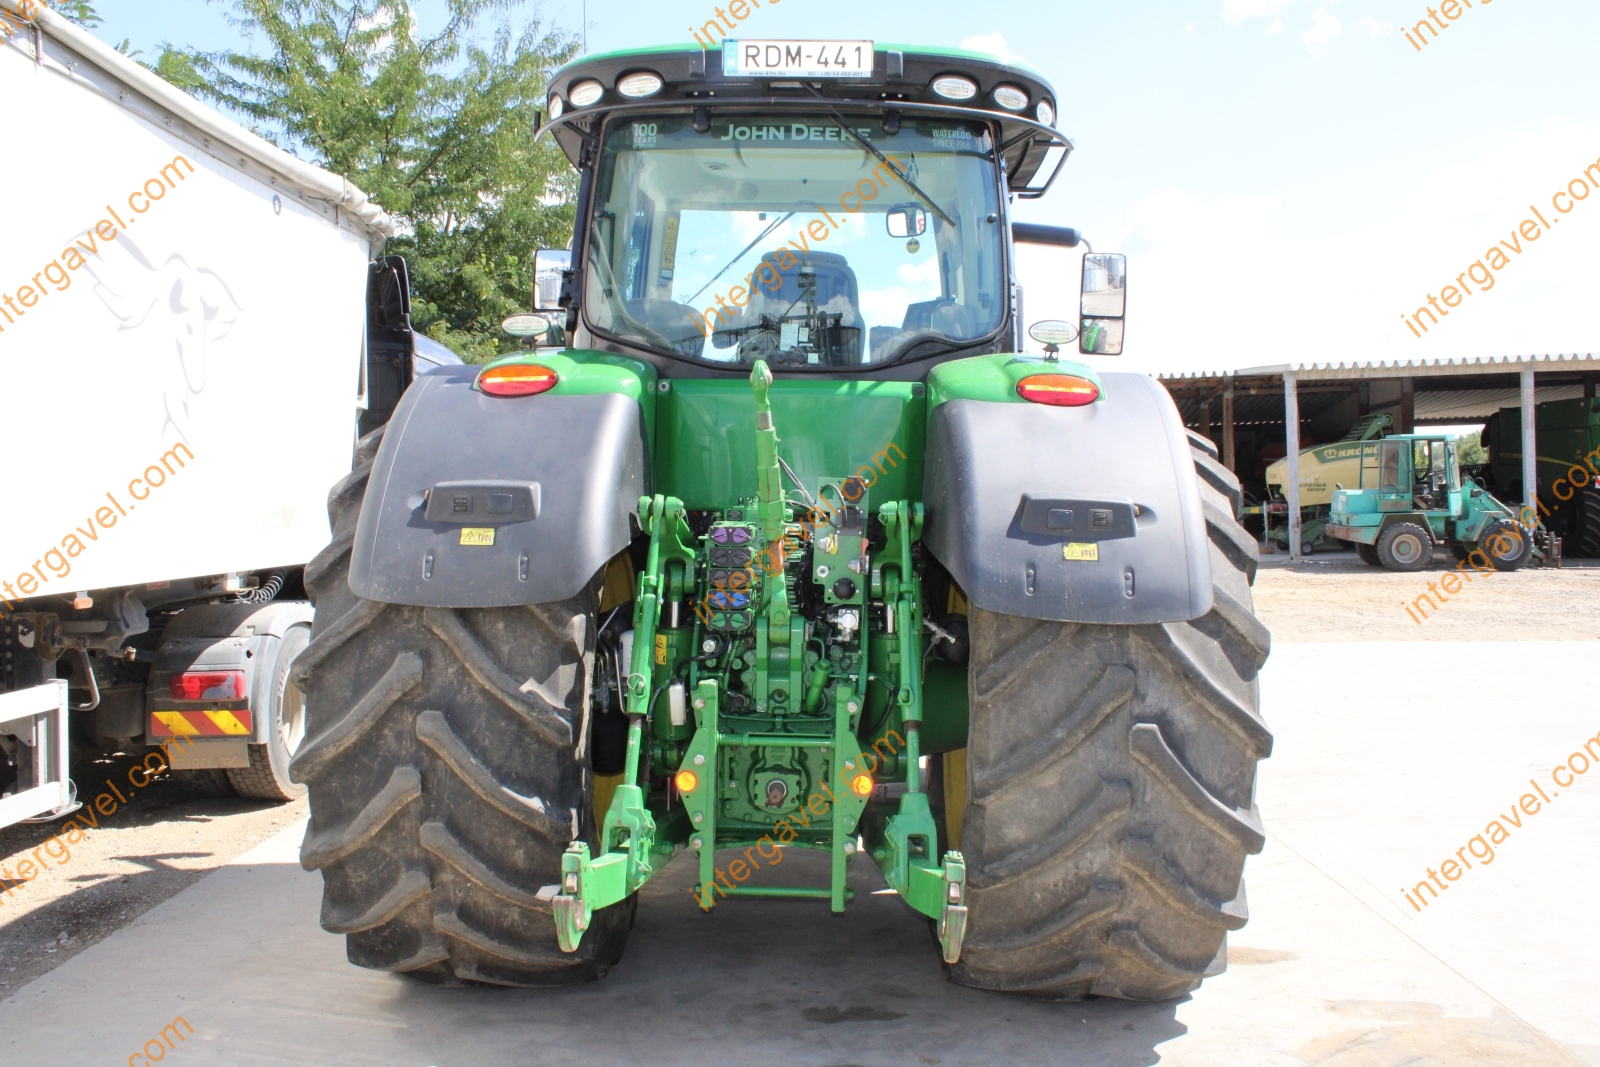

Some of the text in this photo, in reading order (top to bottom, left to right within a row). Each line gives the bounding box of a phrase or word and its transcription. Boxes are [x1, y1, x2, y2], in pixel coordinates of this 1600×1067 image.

[745, 45, 862, 68] RDM-441
[633, 123, 657, 137] 100
[932, 129, 971, 140] WATERLOO
[633, 136, 657, 144] YEARS
[932, 138, 971, 150] SINCE 1918
